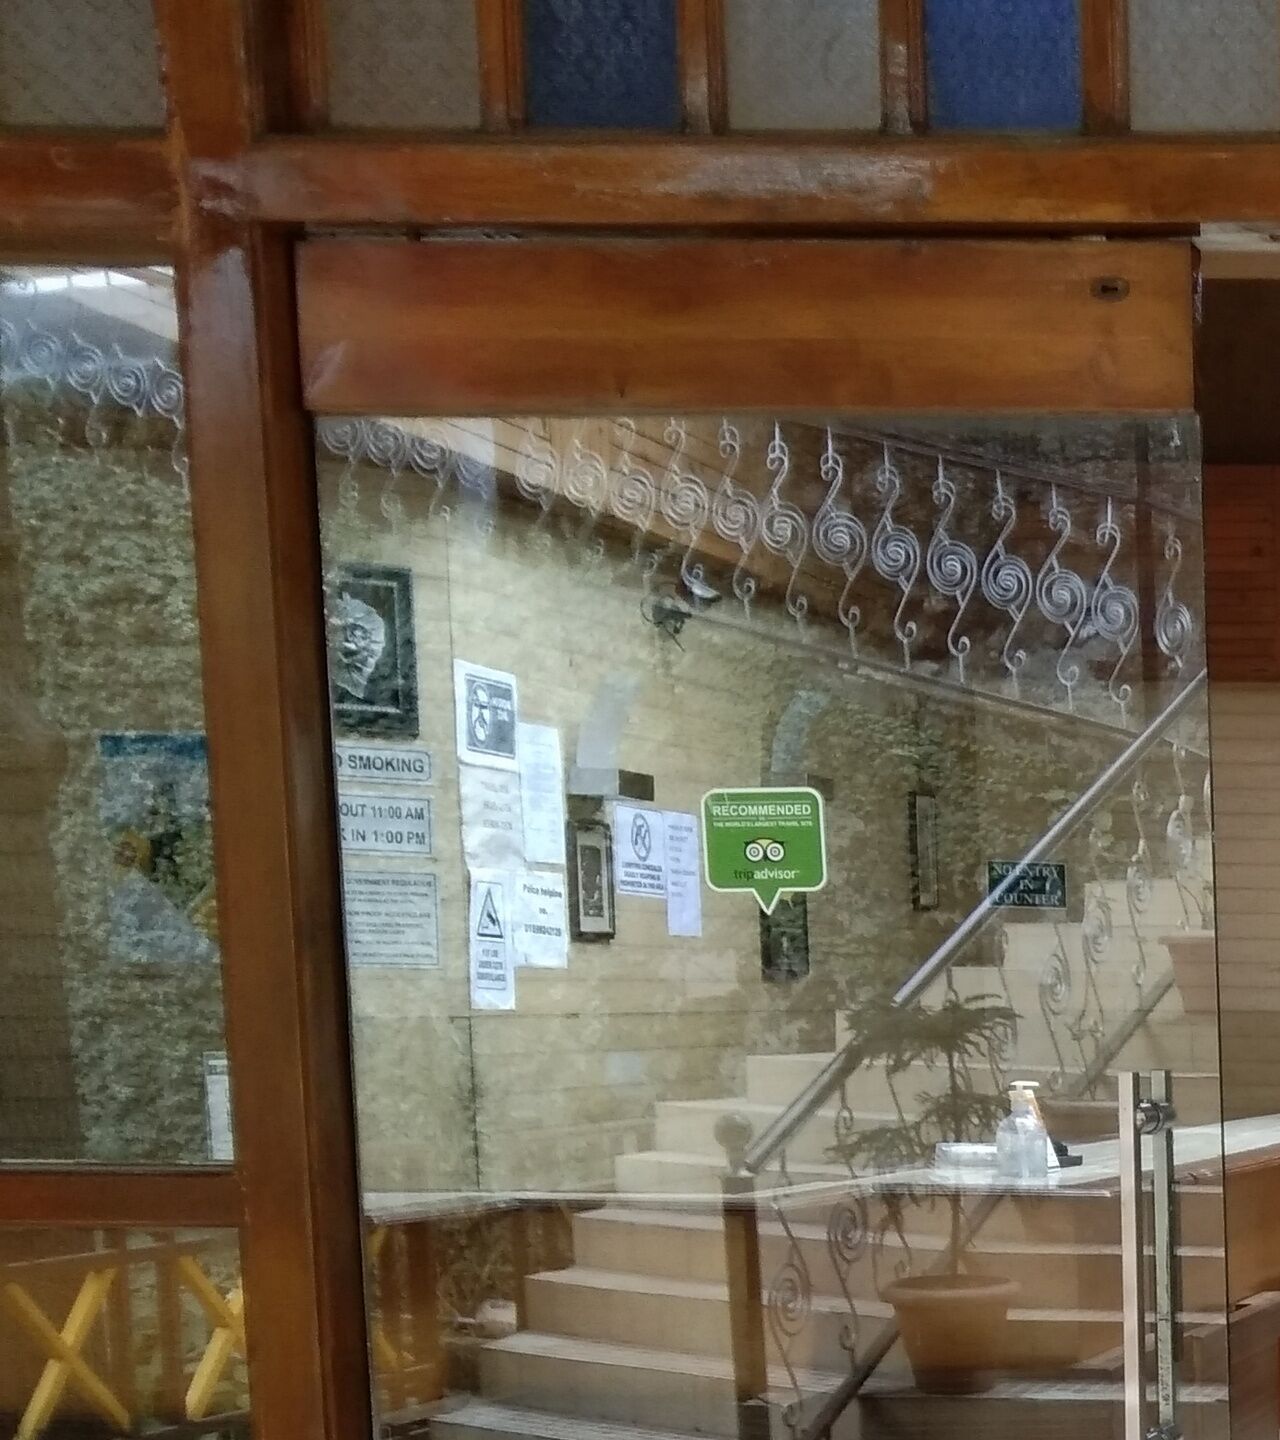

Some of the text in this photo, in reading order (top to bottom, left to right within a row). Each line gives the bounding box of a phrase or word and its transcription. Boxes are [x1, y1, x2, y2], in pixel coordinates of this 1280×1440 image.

[347, 754, 425, 773] SMOKING
[340, 803, 424, 820] OUT 11:00 AM
[712, 804, 811, 816] RECOMMENDED
[351, 829, 366, 842] IN
[372, 830, 403, 844] 1:00
[407, 831, 425, 845] PM
[734, 868, 799, 880] tripadvisor
[993, 863, 1012, 875] NO
[1020, 880, 1034, 890] IN
[995, 892, 1059, 905] COUNTER
